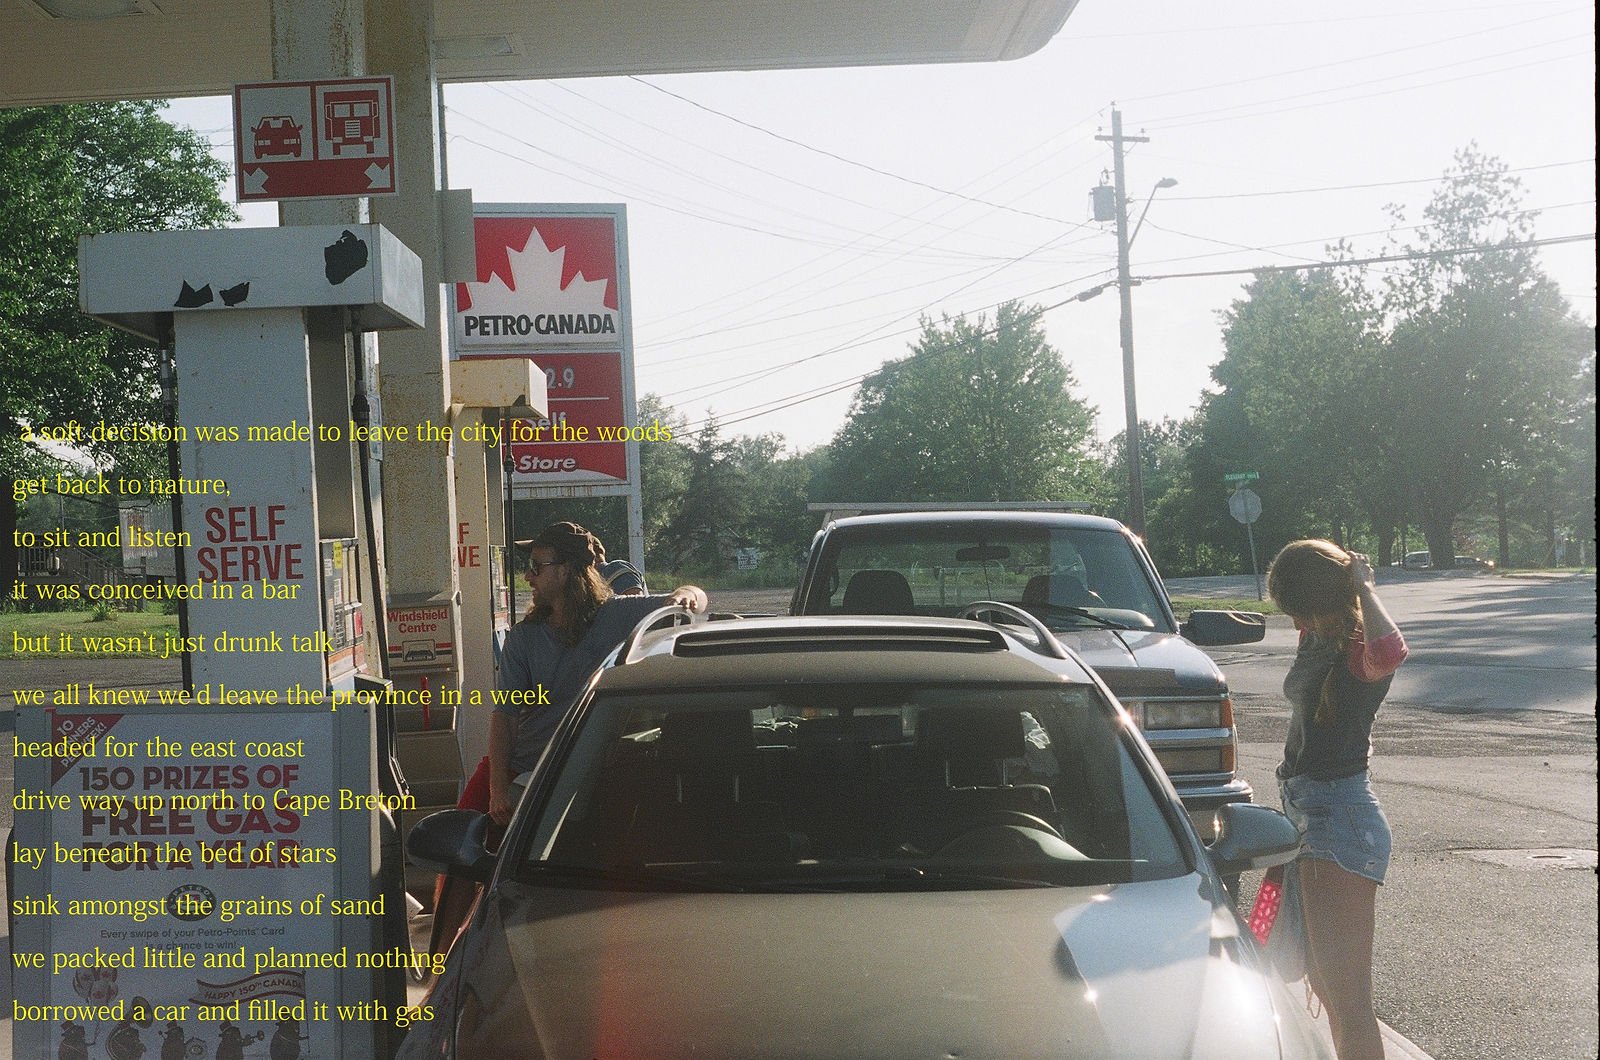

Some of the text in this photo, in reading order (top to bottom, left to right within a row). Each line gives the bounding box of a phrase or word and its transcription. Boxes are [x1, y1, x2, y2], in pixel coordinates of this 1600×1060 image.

[464, 313, 616, 337] PETRO-CANADA
[519, 455, 577, 471] Store
[205, 505, 286, 544] SELF
[197, 544, 304, 584] SERVE
[387, 608, 448, 623] Windshield
[398, 623, 437, 634] Centre
[57, 720, 74, 736] 10
[57, 716, 97, 755] WNNERS
[79, 764, 299, 791] 150 PRIZES OF
[82, 797, 301, 836] FREE GAS
[81, 841, 160, 872] FOR
[165, 840, 194, 871] A
[100, 929, 128, 940] Every
[130, 929, 159, 939] swipe
[161, 928, 171, 937] of
[174, 930, 196, 939] your
[261, 926, 285, 936] Card
[166, 941, 201, 950] chance
[216, 940, 237, 949] win!
[204, 990, 237, 1000] HAPPY
